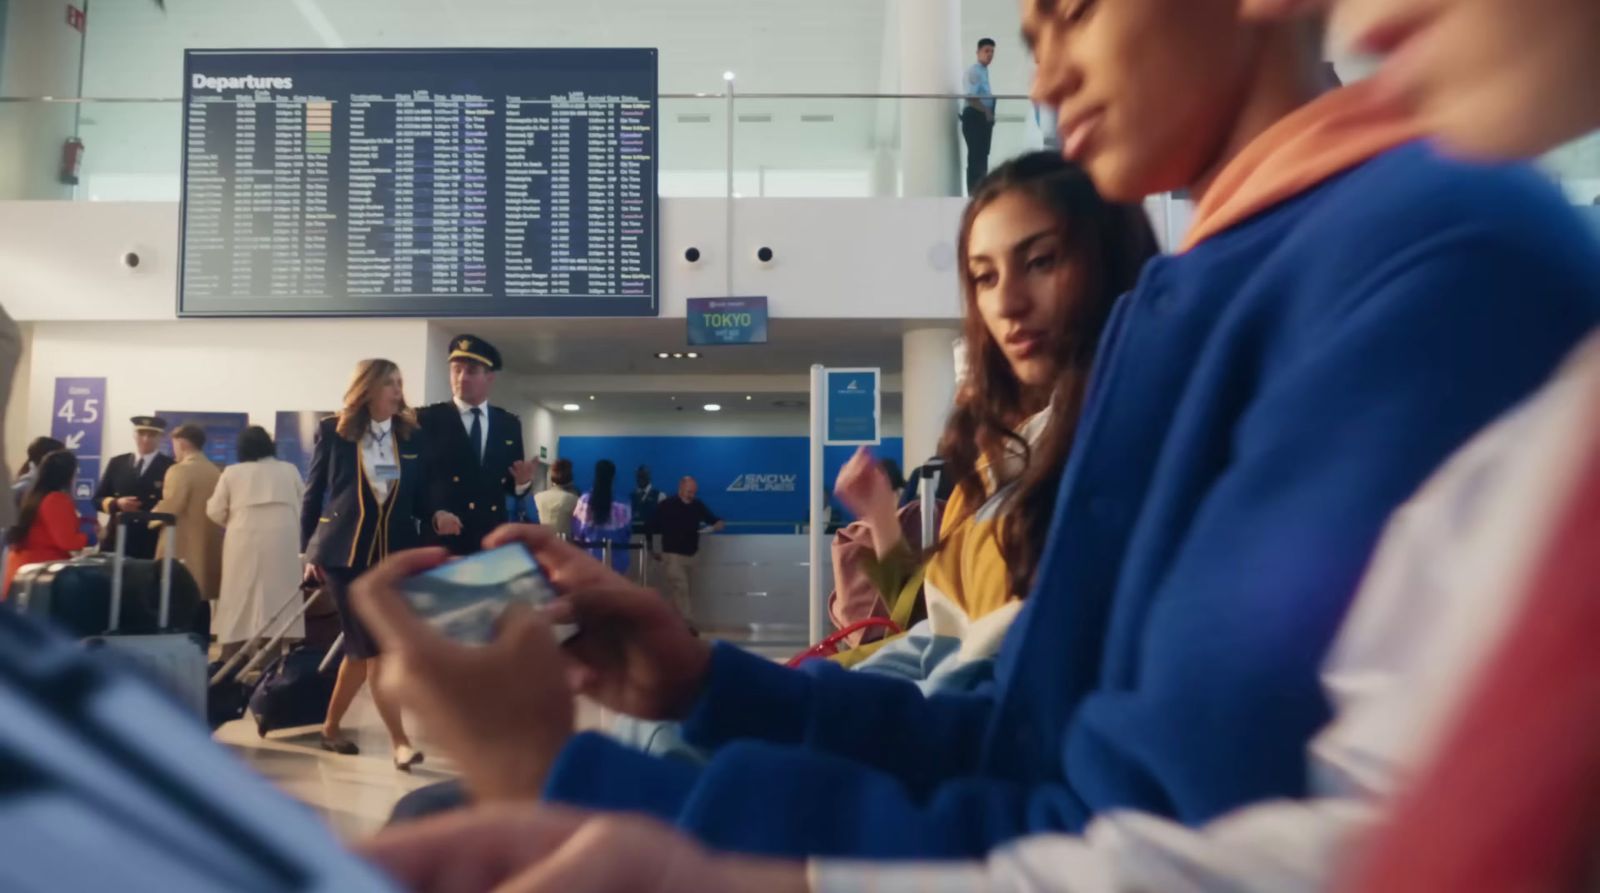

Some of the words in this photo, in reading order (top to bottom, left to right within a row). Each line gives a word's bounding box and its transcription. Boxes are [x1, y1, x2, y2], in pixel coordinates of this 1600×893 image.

[192, 73, 292, 92] Departures
[703, 313, 751, 327] TOKYO
[57, 399, 75, 423] 4
[83, 399, 98, 423] 5
[745, 474, 796, 482] SNOW
